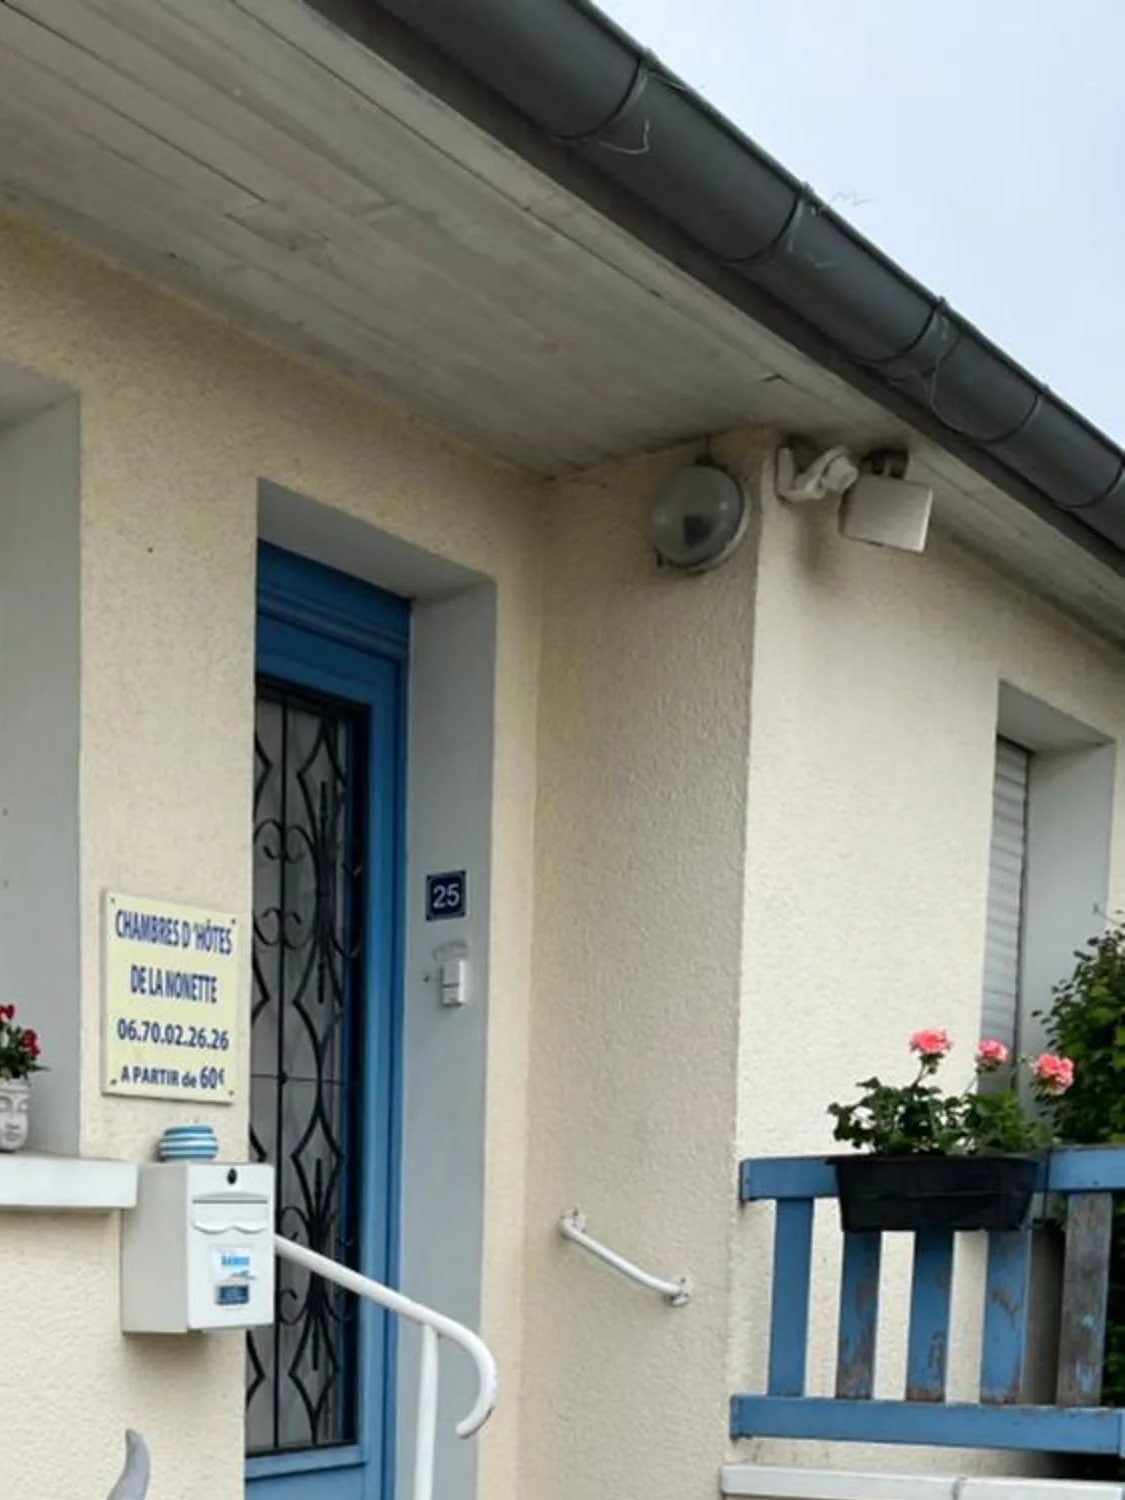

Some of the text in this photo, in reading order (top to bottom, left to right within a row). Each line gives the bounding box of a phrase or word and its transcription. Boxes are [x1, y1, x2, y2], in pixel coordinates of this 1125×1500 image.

[432, 883, 460, 909] 25
[115, 909, 179, 947] CHAMBRES
[131, 964, 217, 1004] DE LA NONETTE
[117, 1017, 230, 1051] 06.70.02.26.26
[121, 1065, 130, 1083] A
[133, 1066, 179, 1087] PARTIR
[181, 1071, 197, 1089] de
